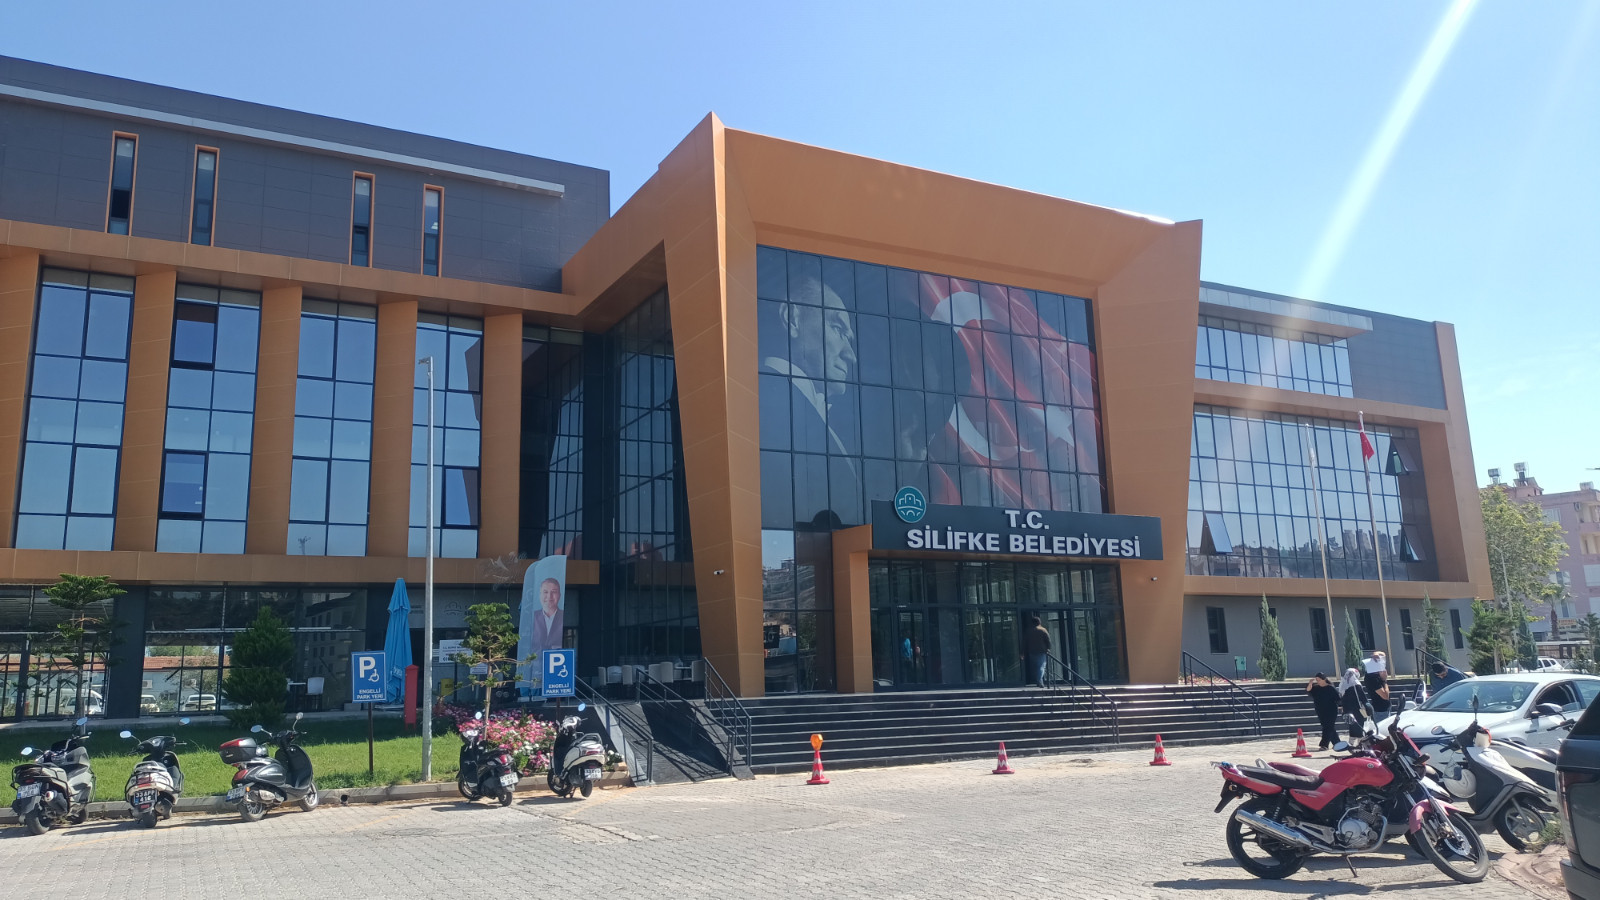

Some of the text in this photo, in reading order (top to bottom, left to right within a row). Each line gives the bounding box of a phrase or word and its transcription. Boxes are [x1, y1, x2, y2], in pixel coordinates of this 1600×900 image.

[1004, 509, 1050, 530] T.C.
[907, 524, 1141, 557] SİLİFKE BELEDİYESİ
[359, 656, 375, 678] P
[549, 653, 565, 674] P
[359, 687, 380, 695] ENGELLİ
